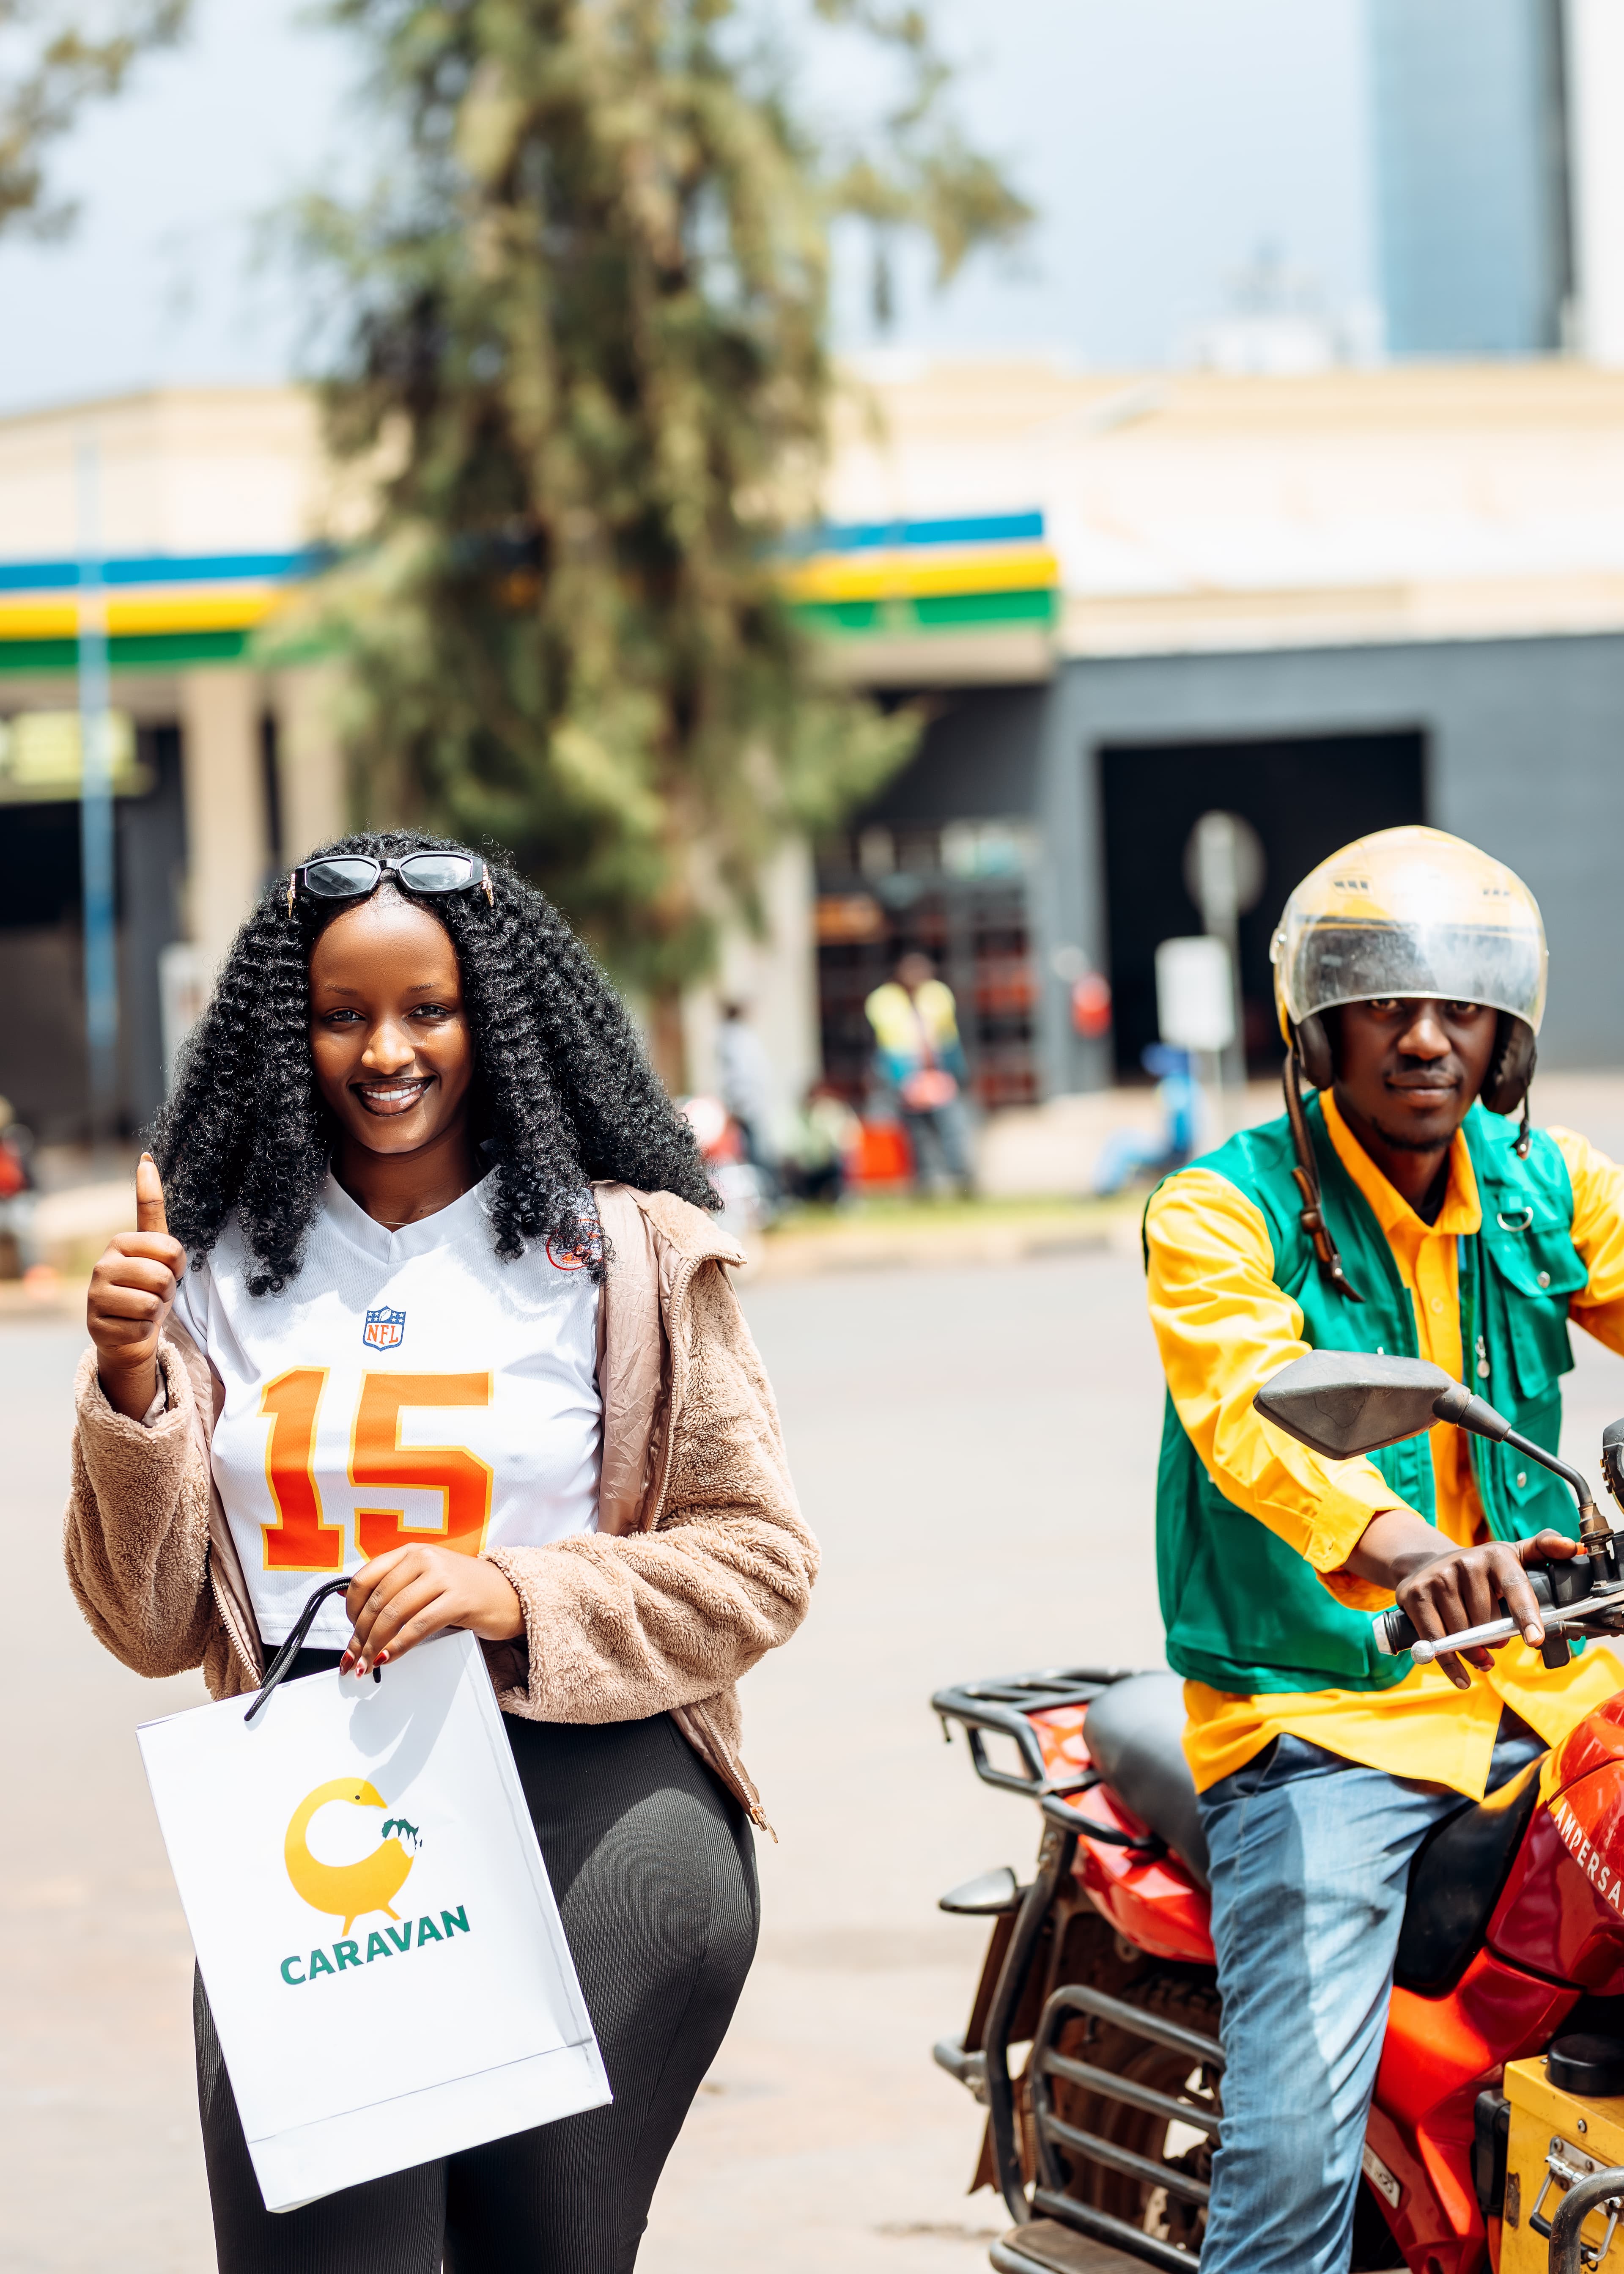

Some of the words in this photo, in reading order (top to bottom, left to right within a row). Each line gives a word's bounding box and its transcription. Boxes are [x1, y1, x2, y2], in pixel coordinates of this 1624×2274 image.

[367, 1324, 398, 1345] NFL
[258, 1366, 493, 1572] 15
[1554, 1802, 1624, 1916] AMPERSA
[280, 1905, 471, 1985] CARAVAN
